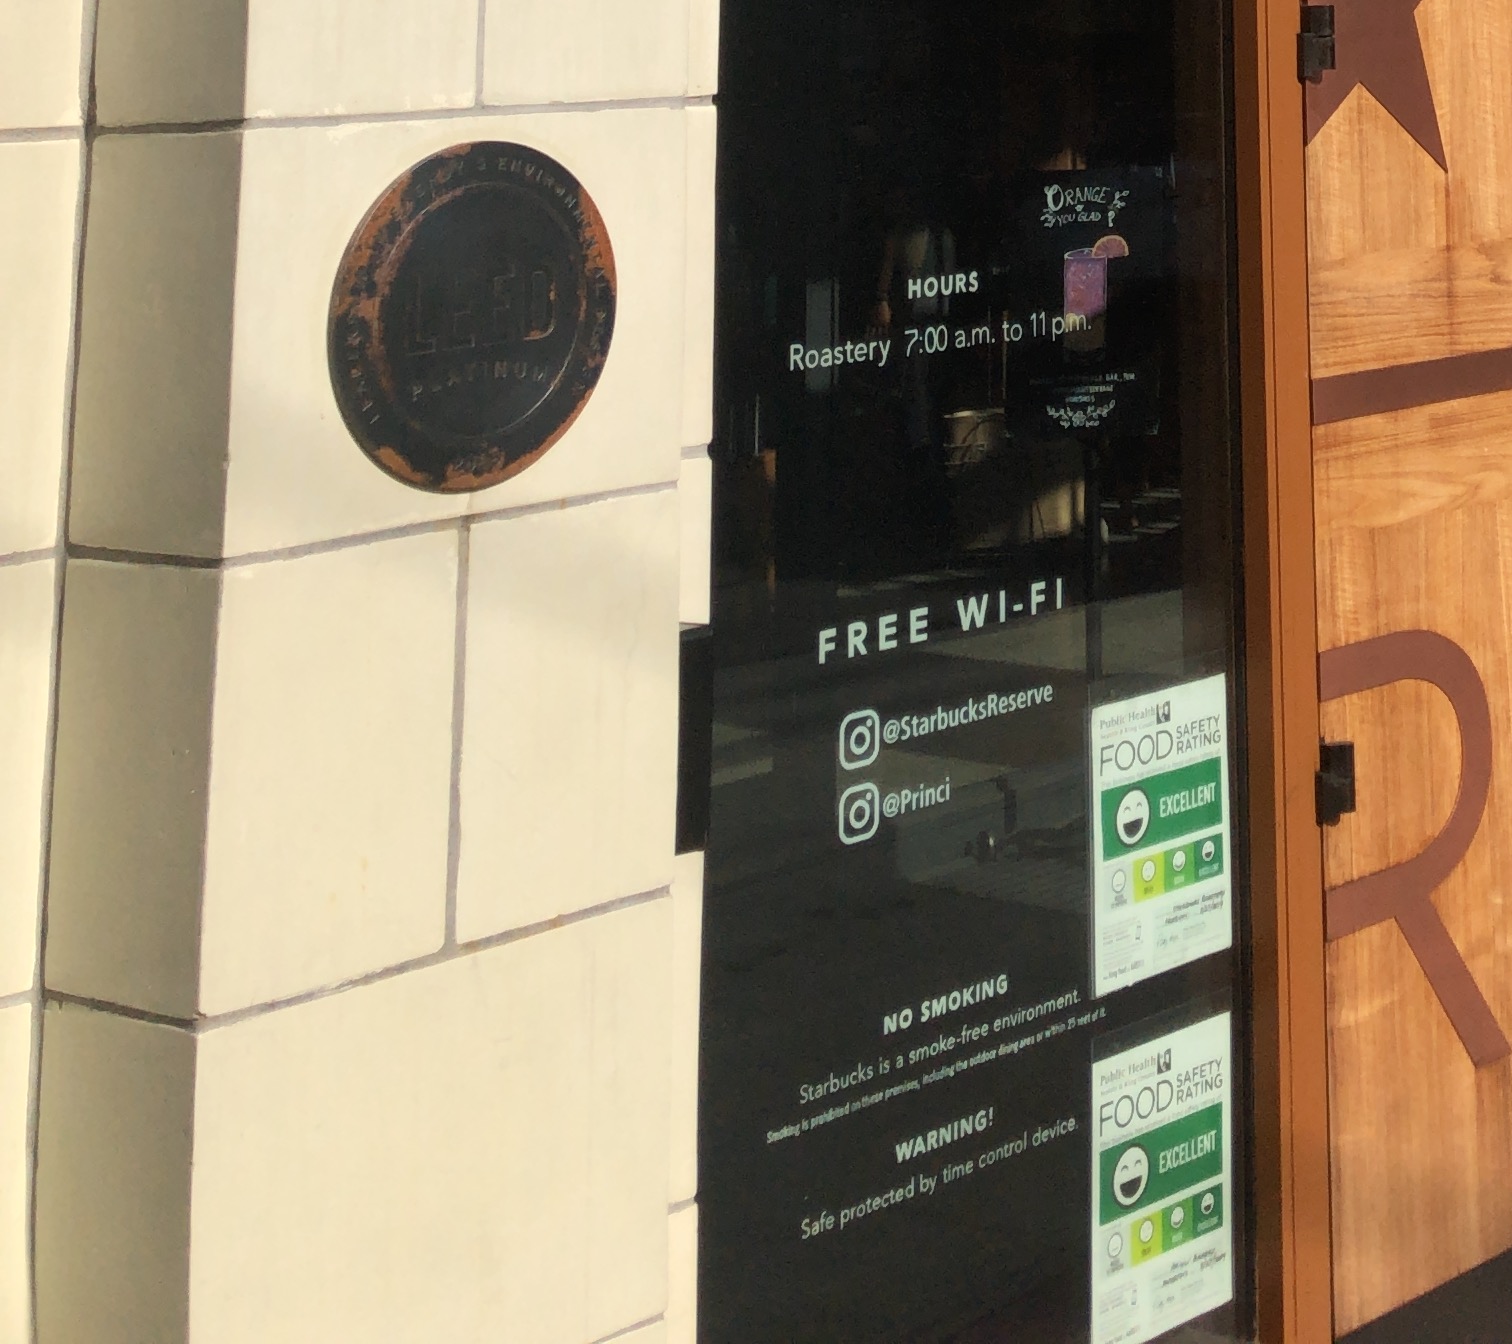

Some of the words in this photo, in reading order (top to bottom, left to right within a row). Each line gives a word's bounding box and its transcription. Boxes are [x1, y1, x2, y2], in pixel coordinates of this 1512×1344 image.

[1055, 212, 1075, 226] YOU
[908, 270, 979, 300] HOURS
[789, 336, 891, 372] Roastery
[904, 325, 948, 358] 7:00
[954, 328, 995, 349] a.m.
[1002, 316, 1023, 343] to
[1030, 312, 1047, 339] 11
[1052, 311, 1092, 346] p.m.
[818, 607, 929, 664] FREE
[956, 577, 1063, 631] WI-FI
[883, 684, 1054, 744] @StarbucksReserve
[1100, 716, 1128, 730] Public
[1129, 705, 1157, 722] Health
[1099, 729, 1173, 777] FOOD
[1176, 714, 1221, 742] SAFETY
[1177, 728, 1222, 755] RATING
[883, 777, 950, 818] @Princi
[1158, 782, 1217, 818] EXCELLENT
[883, 1008, 912, 1035] NO
[920, 974, 1008, 1023] SMOKING
[799, 1063, 873, 1104] Starbucks
[879, 1057, 890, 1075] is
[896, 1055, 903, 1068] a
[909, 1024, 989, 1065] smoke-free
[993, 989, 1081, 1032] environment.
[1100, 1062, 1128, 1086] Public
[1129, 1055, 1156, 1077] Health
[1100, 1080, 1173, 1136] FOOD
[1176, 1057, 1222, 1088] SAFETY
[1176, 1073, 1223, 1105] RATING
[895, 1108, 994, 1165] WARNING!
[1158, 1129, 1217, 1174] EXCELLENT
[801, 1216, 835, 1240] Safe
[840, 1184, 916, 1229] protected
[919, 1172, 938, 1199] by
[943, 1161, 973, 1183] time
[978, 1138, 1028, 1176] control
[1032, 1117, 1079, 1149] device.
